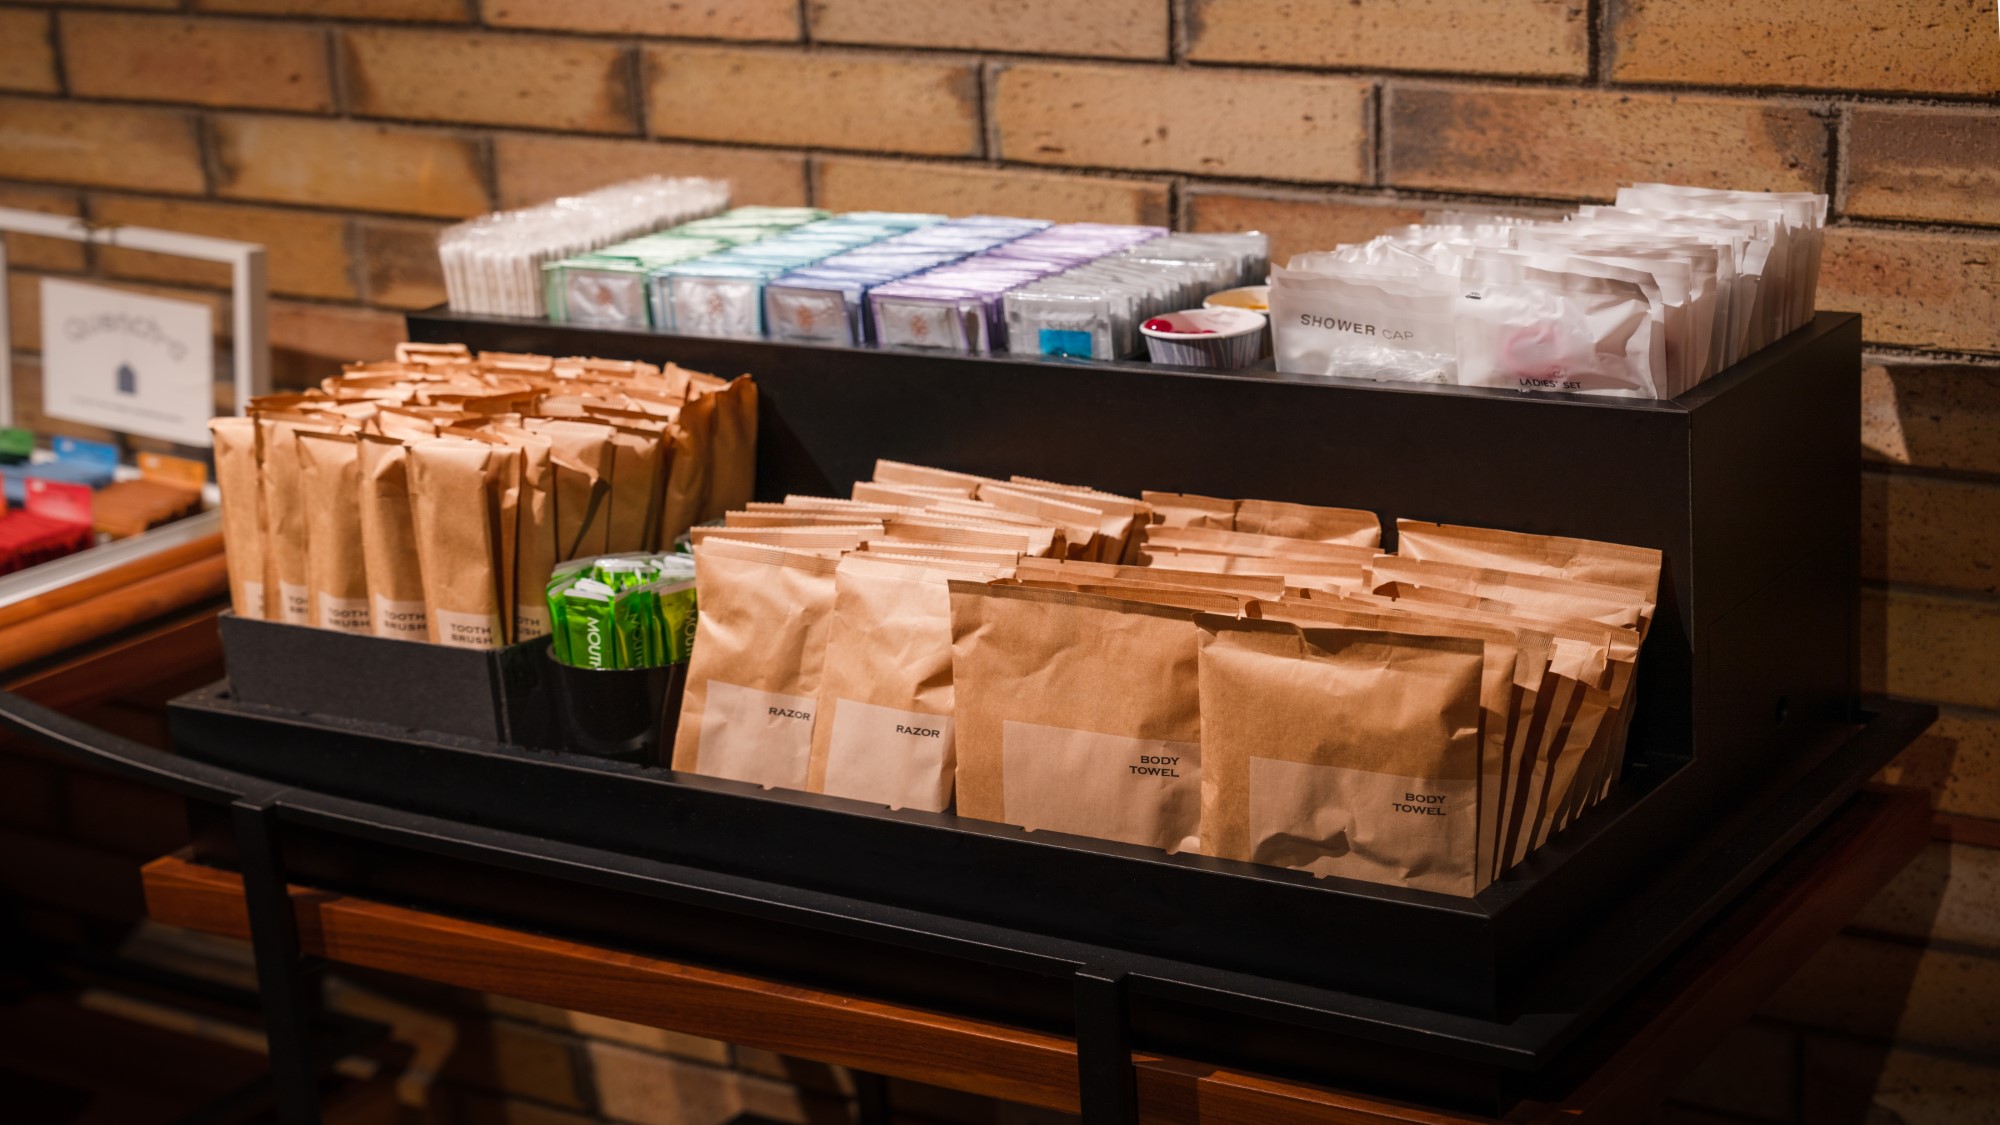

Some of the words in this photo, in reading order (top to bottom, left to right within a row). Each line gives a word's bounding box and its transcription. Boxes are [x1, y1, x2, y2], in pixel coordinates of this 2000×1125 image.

[1300, 313, 1376, 336] SHOWER
[1381, 329, 1415, 341] CAP
[1519, 378, 1558, 388] LADIES'
[1562, 381, 1581, 389] SET
[449, 623, 492, 635] TOOTH
[451, 634, 493, 645] BRUSH
[768, 707, 811, 721] RAZOR
[896, 724, 941, 738] RAZOR
[1140, 755, 1180, 766] BODY
[1129, 765, 1180, 778] TOWEL
[1405, 793, 1447, 804] BODY
[1392, 803, 1447, 816] TOWEL
